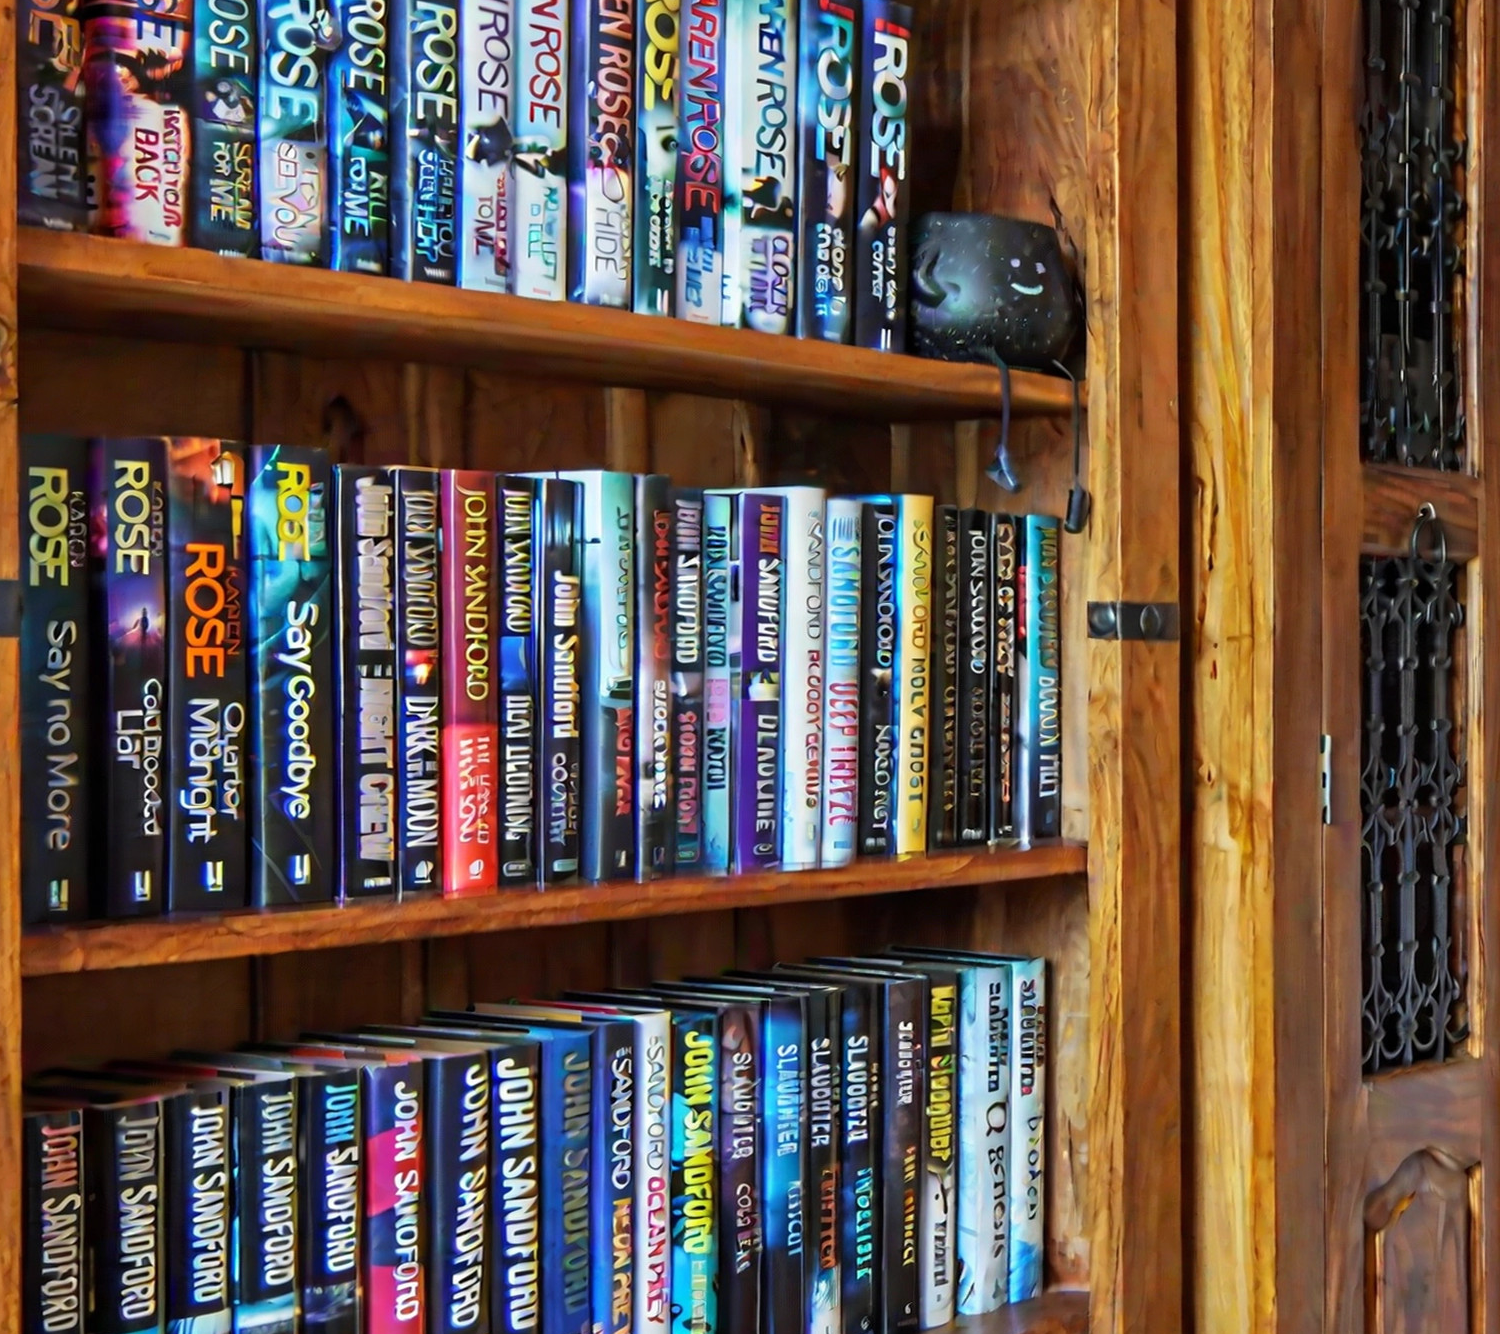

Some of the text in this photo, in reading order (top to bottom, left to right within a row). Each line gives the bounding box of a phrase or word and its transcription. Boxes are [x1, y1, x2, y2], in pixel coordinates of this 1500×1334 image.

[417, 1, 458, 124] ROSE
[478, 4, 513, 113] ROSE
[529, 23, 562, 127] ROSE
[597, 43, 633, 142] ROSE
[755, 75, 787, 180] ROSE
[871, 33, 910, 179] ROSE
[134, 127, 159, 201] BACK
[684, 92, 721, 214] ROSE
[113, 459, 150, 575] ROSE
[458, 486, 486, 559] JOHN
[29, 468, 78, 850] ROSE Say no More
[185, 542, 225, 677] ROSE
[274, 463, 318, 820] ROSE Say Goodbye
[464, 565, 489, 701] SANDFORD
[117, 710, 140, 768] Liar
[180, 698, 220, 843] Midnight
[406, 696, 438, 847] DARK MOON
[190, 1107, 226, 1304] JOHN SANDFORD
[261, 1092, 296, 1286] JOHN SANDFORD
[325, 1084, 358, 1272] JOHN SANDFORD
[393, 1082, 419, 1322] JOHN SANDFORD
[451, 1064, 489, 1328] JOHN SANDFORD
[495, 1058, 538, 1331] JOHN SANDFORD
[684, 1031, 712, 1254] JOHN SANDFORD
[41, 1126, 81, 1332] JOHN SANDFORD
[118, 1117, 159, 1320] JOHN SANDFORD
